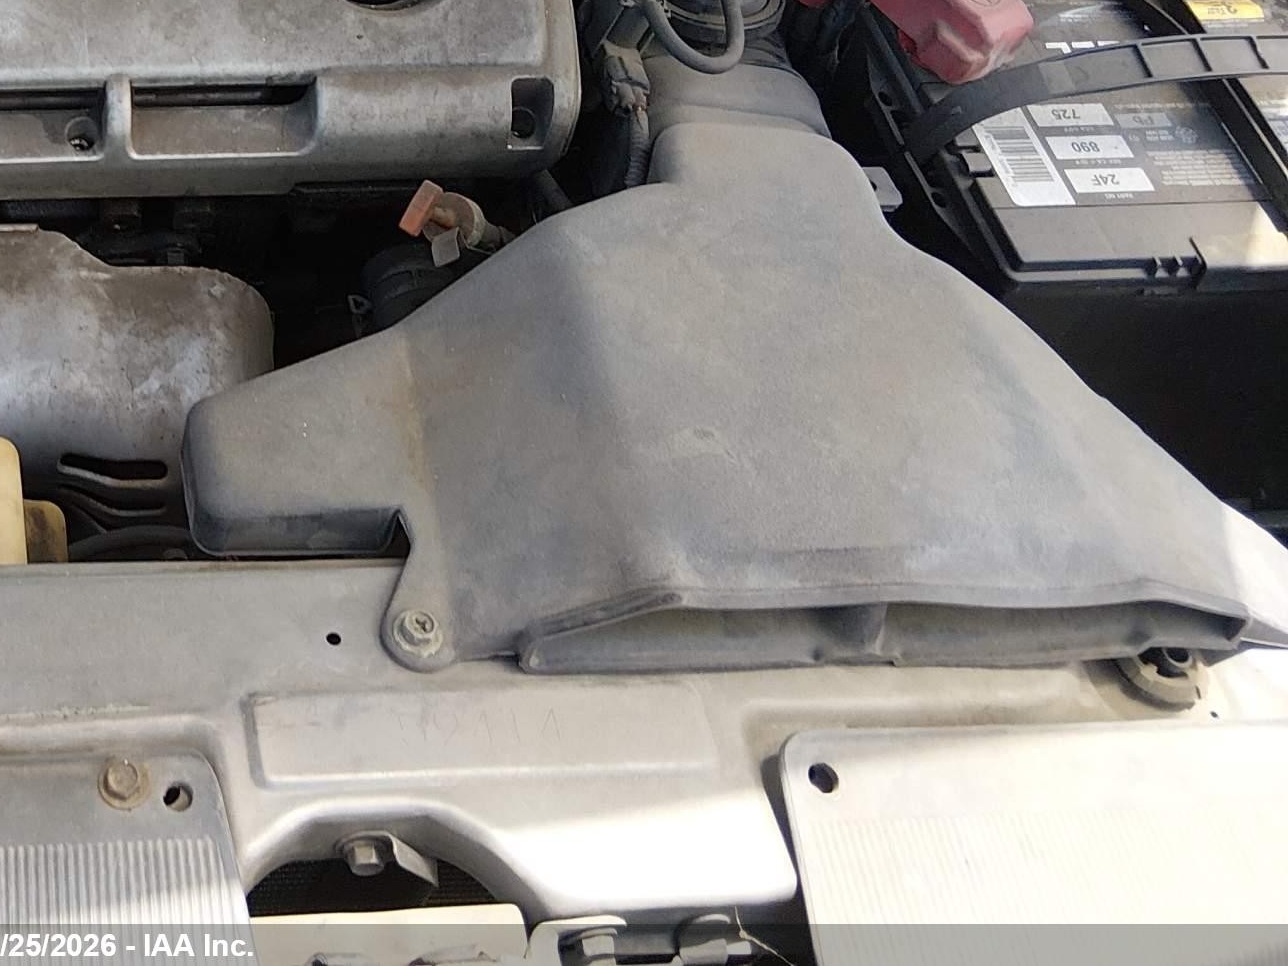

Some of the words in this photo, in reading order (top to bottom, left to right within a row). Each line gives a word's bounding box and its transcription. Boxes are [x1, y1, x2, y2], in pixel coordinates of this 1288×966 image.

[1051, 108, 1080, 121] 725
[1072, 141, 1100, 153] 890
[1091, 173, 1120, 187] 24F
